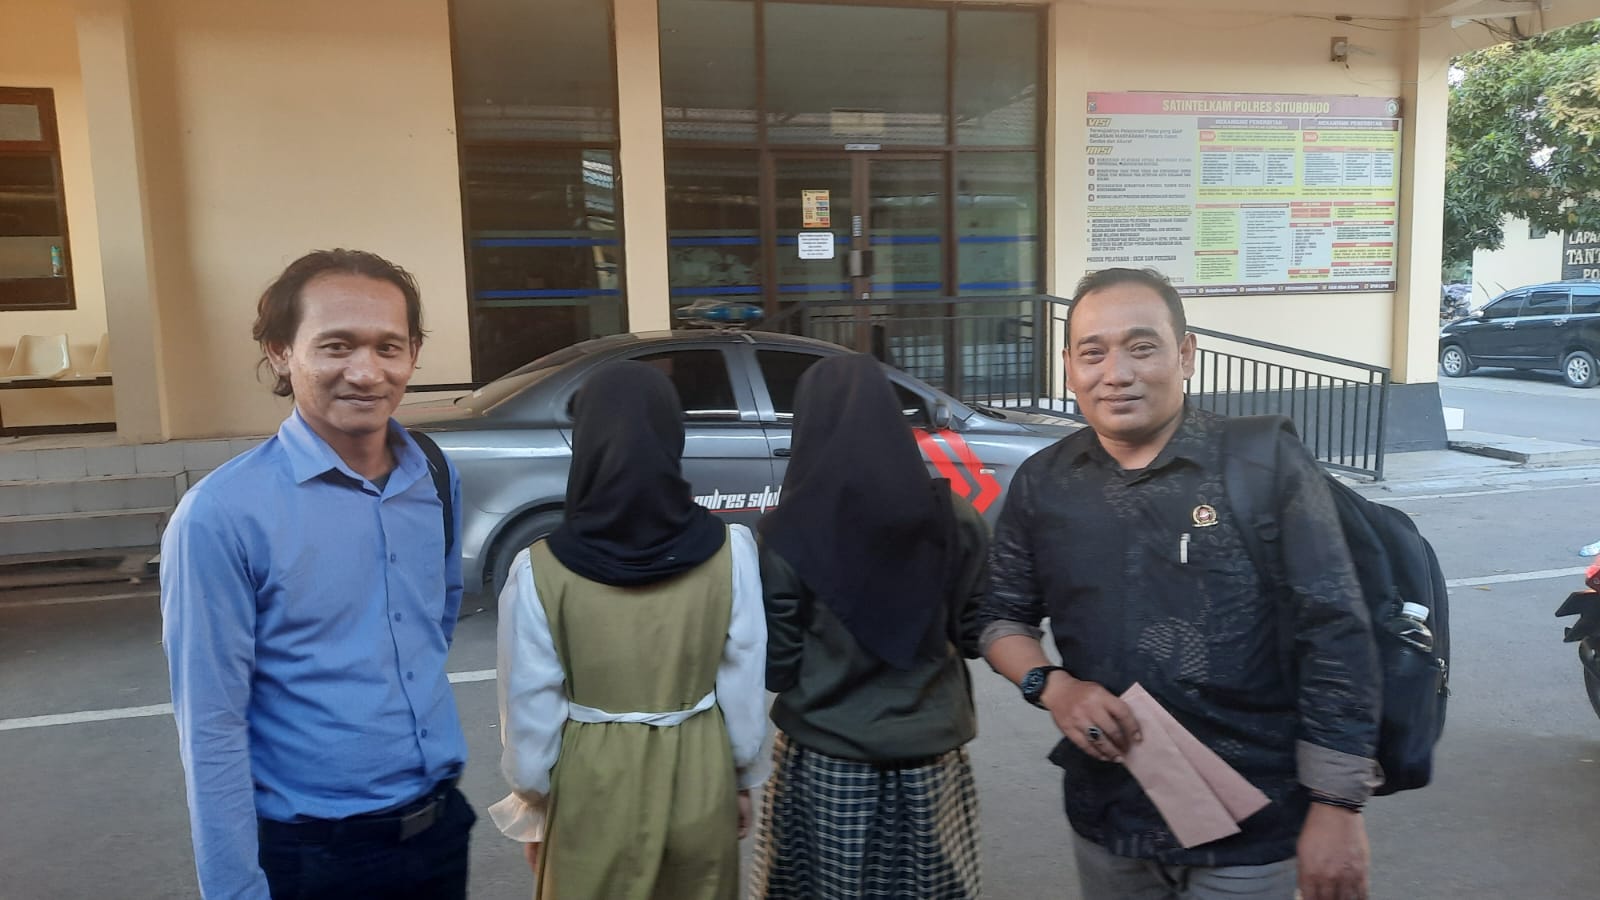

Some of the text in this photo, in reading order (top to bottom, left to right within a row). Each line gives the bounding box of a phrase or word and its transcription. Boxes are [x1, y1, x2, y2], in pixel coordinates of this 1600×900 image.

[1162, 99, 1330, 114] SATINTELKAM POLRES SITUBONDO
[1089, 117, 1111, 127] VISI
[1087, 145, 1113, 154] MISI
[1569, 231, 1600, 244] LAPA
